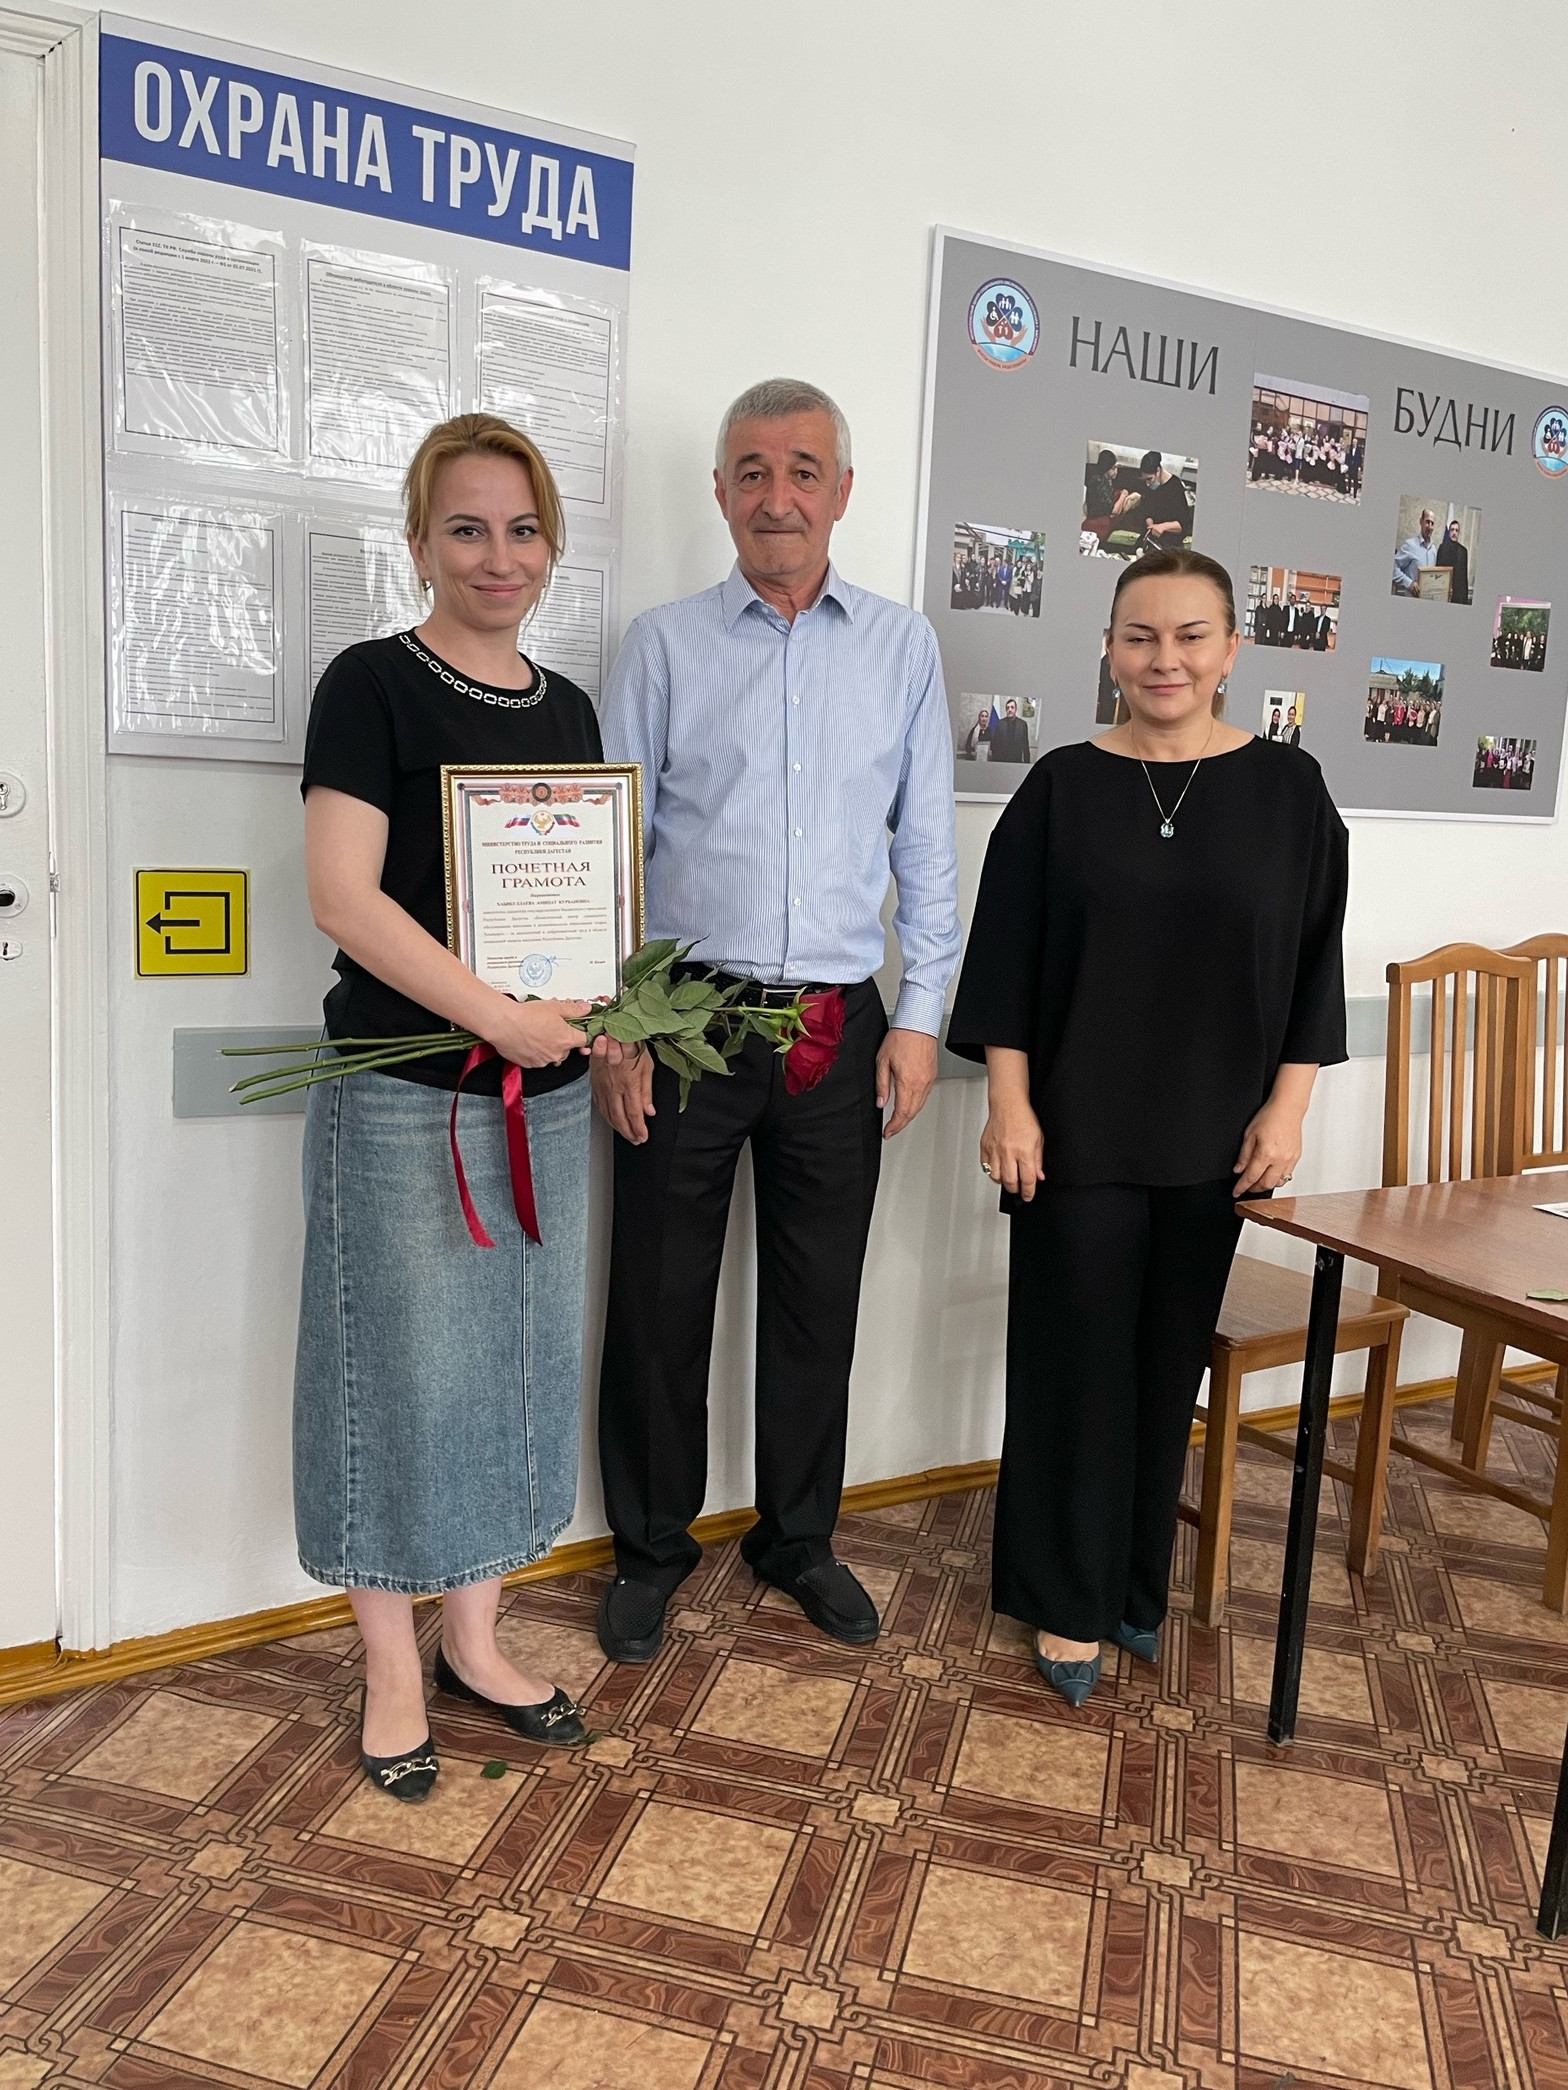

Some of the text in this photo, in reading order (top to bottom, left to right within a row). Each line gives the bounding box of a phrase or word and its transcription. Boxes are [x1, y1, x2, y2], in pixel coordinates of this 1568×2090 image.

[134, 61, 600, 240] ОХРАНА ТРУДА
[1069, 316, 1219, 395] НАШИ
[1393, 387, 1516, 456] БУДНИ
[492, 862, 591, 874] ПОЧЕТНАЯ
[502, 876, 587, 889] ГРАМОТА
